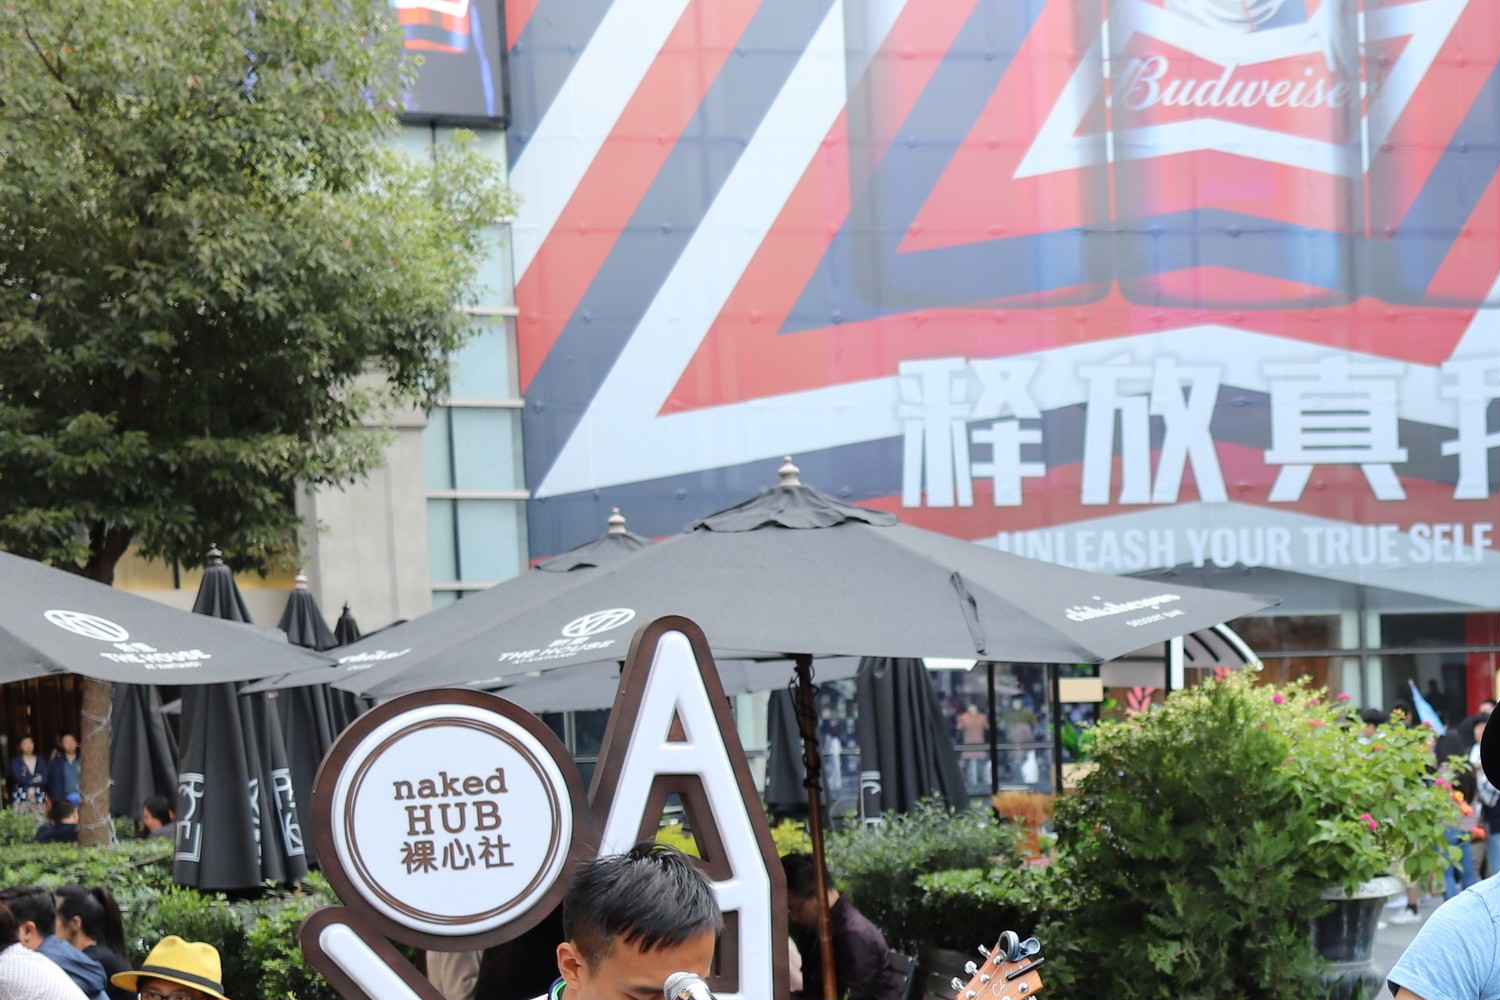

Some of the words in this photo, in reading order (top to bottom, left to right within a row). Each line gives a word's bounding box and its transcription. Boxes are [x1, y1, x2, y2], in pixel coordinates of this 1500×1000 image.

[1188, 526, 1292, 570] YOUR
[1302, 524, 1400, 566] TRUE
[1409, 522, 1493, 564] SELF
[393, 767, 508, 800] naked
[405, 800, 502, 836] HUB
[400, 834, 514, 875] 裸心社
